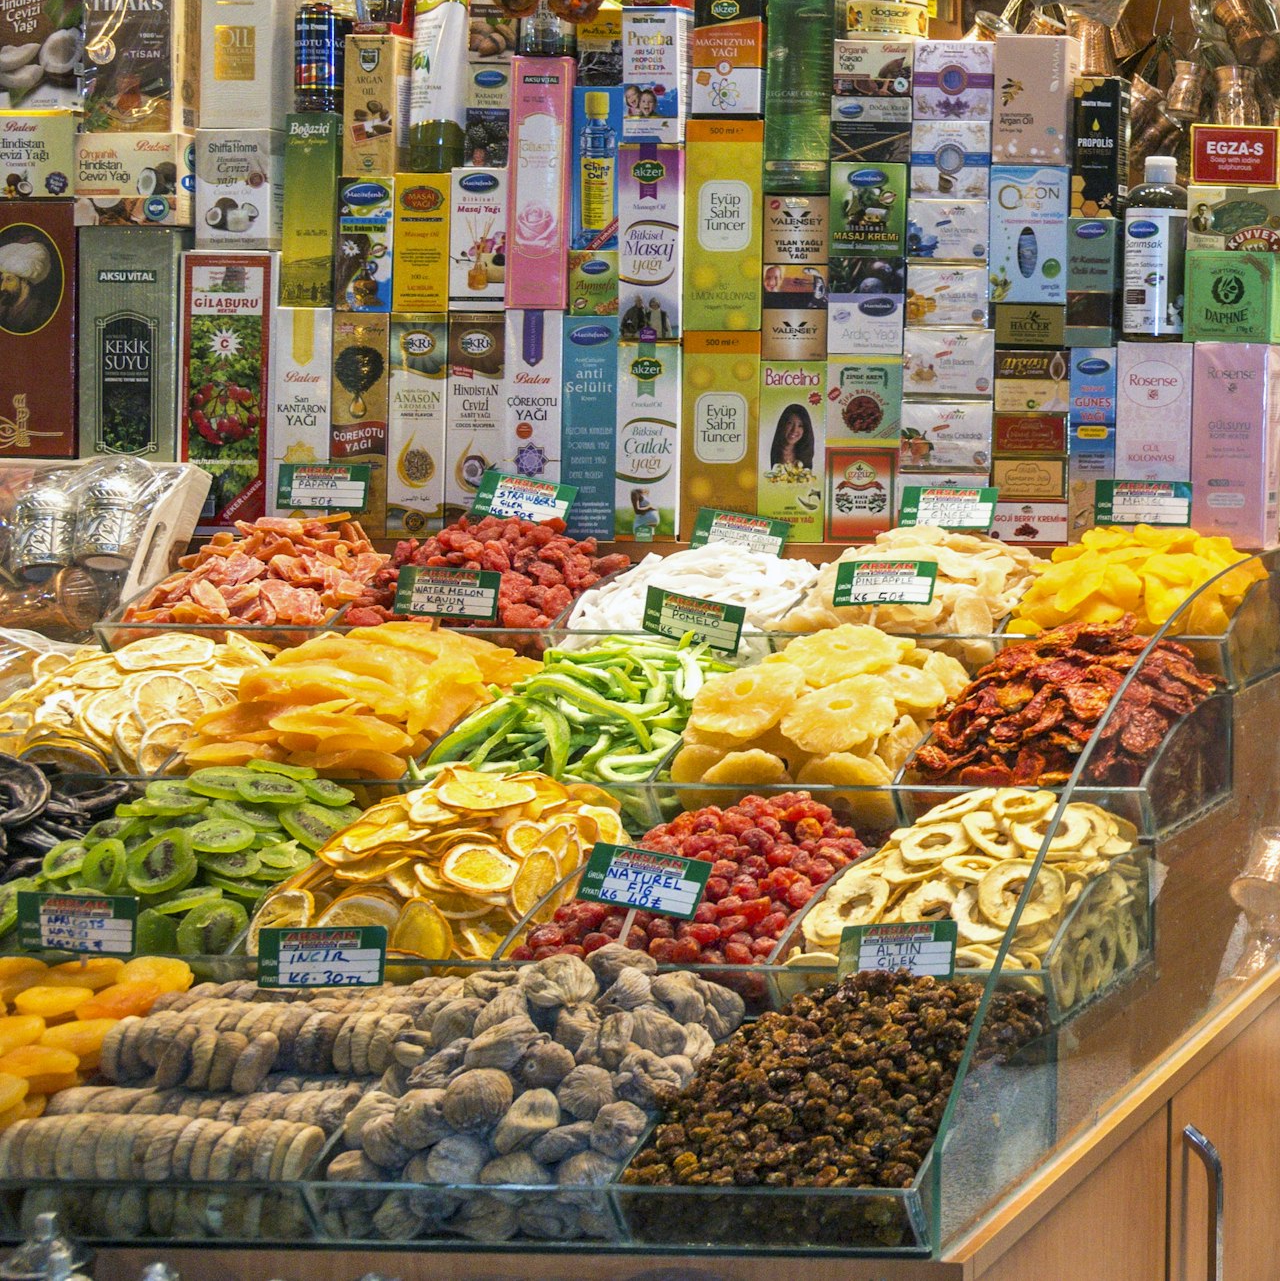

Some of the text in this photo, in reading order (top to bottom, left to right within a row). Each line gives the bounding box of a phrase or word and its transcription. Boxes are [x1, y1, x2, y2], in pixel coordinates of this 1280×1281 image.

[6, 6, 41, 23] Cevizi
[713, 5, 739, 15] akzer
[13, 19, 38, 34] Yağı
[218, 28, 254, 48] OIL
[696, 38, 755, 48] MAGNEZYUM
[711, 46, 738, 58] YAĞI
[839, 45, 869, 56] Organik
[839, 55, 863, 63] Kakao
[355, 76, 384, 85] ARGAN
[524, 76, 540, 84] AKSU
[361, 87, 376, 97] OIL
[1000, 116, 1020, 126] Argan
[289, 121, 331, 139] Boğaziçi
[709, 127, 725, 135] 500
[208, 142, 258, 153] Shiffa Home
[1077, 137, 1114, 149] PROPOLİS
[1206, 141, 1264, 156] EGZA-S
[24, 148, 50, 163] Yağı
[79, 148, 118, 161] Organik
[1209, 155, 1261, 165] Soap with iodine
[79, 160, 123, 171] Hindistan
[217, 161, 250, 174] Cevizi
[583, 162, 610, 174] China
[79, 170, 131, 184] Cevizi Yağı
[587, 172, 604, 180] Oel
[632, 167, 664, 178] akzer
[216, 173, 239, 188] yağı
[407, 193, 435, 201] MASAJ
[710, 192, 741, 206] Eyüp
[411, 199, 431, 208] YAĞI
[457, 205, 482, 215] Masaj
[709, 205, 741, 219] Sabri
[704, 218, 746, 232] Tuncer
[770, 217, 823, 227] VALENSEY
[630, 230, 665, 242] Bitkisel
[833, 231, 899, 242] MASAJ KREMİ
[1227, 229, 1279, 250] KUVVET
[774, 239, 823, 247] YILAN YAĞLI
[1126, 239, 1164, 250] Sarımsak
[624, 238, 675, 262] Masaj
[777, 246, 820, 255] SAÇ BAKIM
[789, 252, 808, 260] YAĞI
[632, 258, 662, 274] yağı
[99, 269, 155, 282] AKSU VİTAL
[194, 296, 259, 309] GİLABURU
[1204, 308, 1249, 323] DAPHNE
[1011, 320, 1050, 331] HACCER
[105, 337, 150, 354] KEKİK
[705, 337, 732, 347] 500 ml
[104, 354, 150, 371] SUYU
[576, 368, 603, 380] anti
[632, 364, 662, 375] akzer
[1207, 367, 1257, 380] Rosense
[764, 367, 821, 387] Barcelino
[1129, 373, 1178, 387] Rosense
[453, 383, 499, 397] HİNDİSTAN
[566, 381, 613, 394] Selülit
[393, 391, 441, 404] ANASON
[507, 394, 558, 409] ÇÖREKOTU
[277, 403, 327, 414] KANTARON
[515, 407, 548, 422] YAĞI
[285, 411, 318, 427] YAĞI
[333, 426, 384, 442] ÇÖREKOTU
[624, 436, 673, 457] Çatlak
[1128, 453, 1175, 463] KOLONYASI
[299, 479, 338, 490] PAPAYA
[502, 476, 556, 491] ARSLAN
[994, 514, 1013, 523] GOJİ
[1014, 514, 1036, 523] BERRY
[855, 576, 914, 587] PINEAPPLE
[414, 586, 484, 598] WATER MELON
[426, 594, 465, 606] KAVUN
[671, 609, 720, 628] POMELO
[619, 850, 684, 869] ARSLAN
[606, 867, 683, 891] NATUREL
[600, 888, 618, 900] KG
[626, 882, 654, 896] FIG
[285, 931, 357, 941] ARSLAN
[867, 925, 930, 936] ARSLAN
[876, 942, 922, 957] ALTIN
[323, 970, 344, 984] 30
[346, 975, 367, 984] TL
